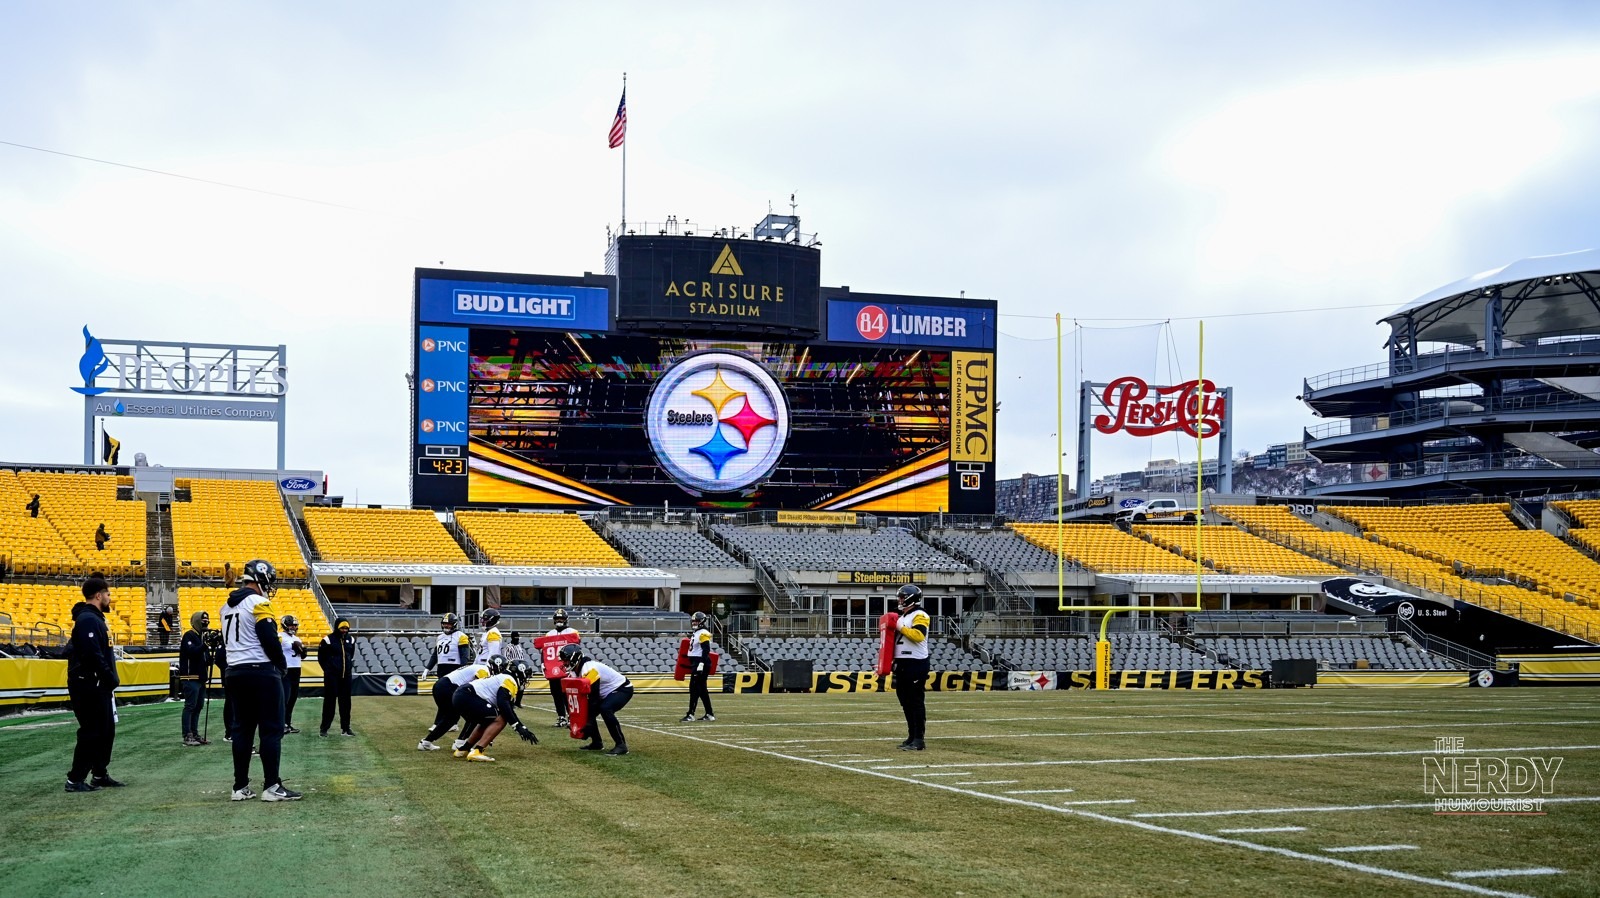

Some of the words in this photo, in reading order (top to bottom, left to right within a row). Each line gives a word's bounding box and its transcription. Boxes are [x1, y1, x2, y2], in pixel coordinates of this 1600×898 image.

[665, 281, 784, 303] ACRISURE
[458, 294, 505, 312] BUD
[507, 297, 571, 316] LIGHT
[690, 302, 761, 317] STADIUM
[860, 312, 885, 333] 84
[891, 313, 967, 337] LUMBER
[437, 340, 466, 353] PNC
[115, 354, 289, 396] PEOPLES
[437, 381, 466, 393] PNC
[95, 402, 111, 412] An
[126, 403, 177, 415] Essential
[180, 406, 222, 416] Utilities
[224, 406, 276, 420] Company
[965, 358, 988, 456] UPMC
[667, 409, 714, 426] Steelers
[436, 421, 466, 433] PNC
[433, 460, 462, 473] 4:23
[285, 477, 311, 490] Ford
[963, 475, 979, 488] 40
[854, 571, 910, 583] Steelers.com
[224, 613, 241, 645] 71
[437, 641, 451, 655] 66
[1068, 669, 1263, 690] SEELERS
[568, 694, 580, 714] 94
